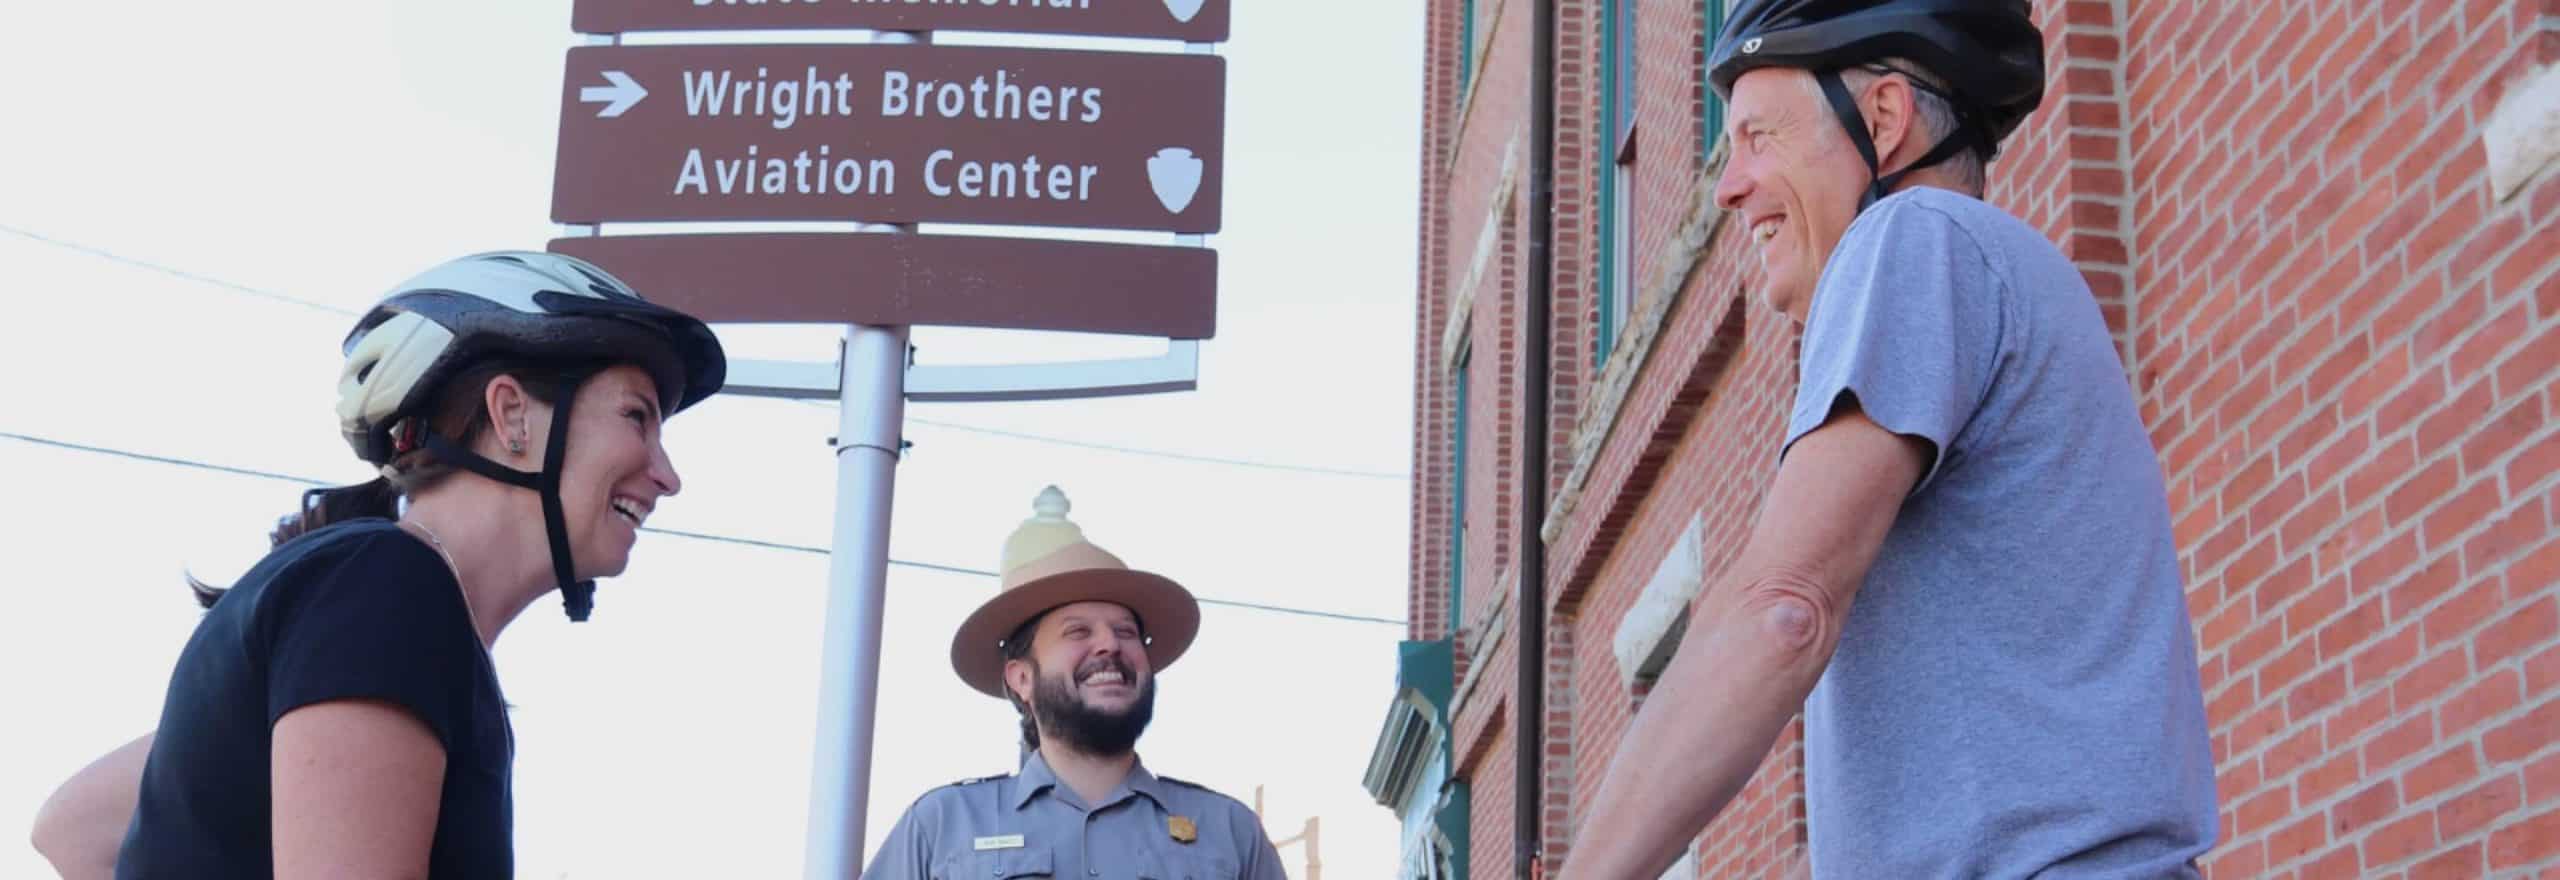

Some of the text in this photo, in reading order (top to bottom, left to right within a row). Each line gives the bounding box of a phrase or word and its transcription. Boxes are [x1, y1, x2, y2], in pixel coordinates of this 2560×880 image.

[683, 67, 1101, 129] Wright Brothers
[675, 145, 1097, 200] Aviation Center
